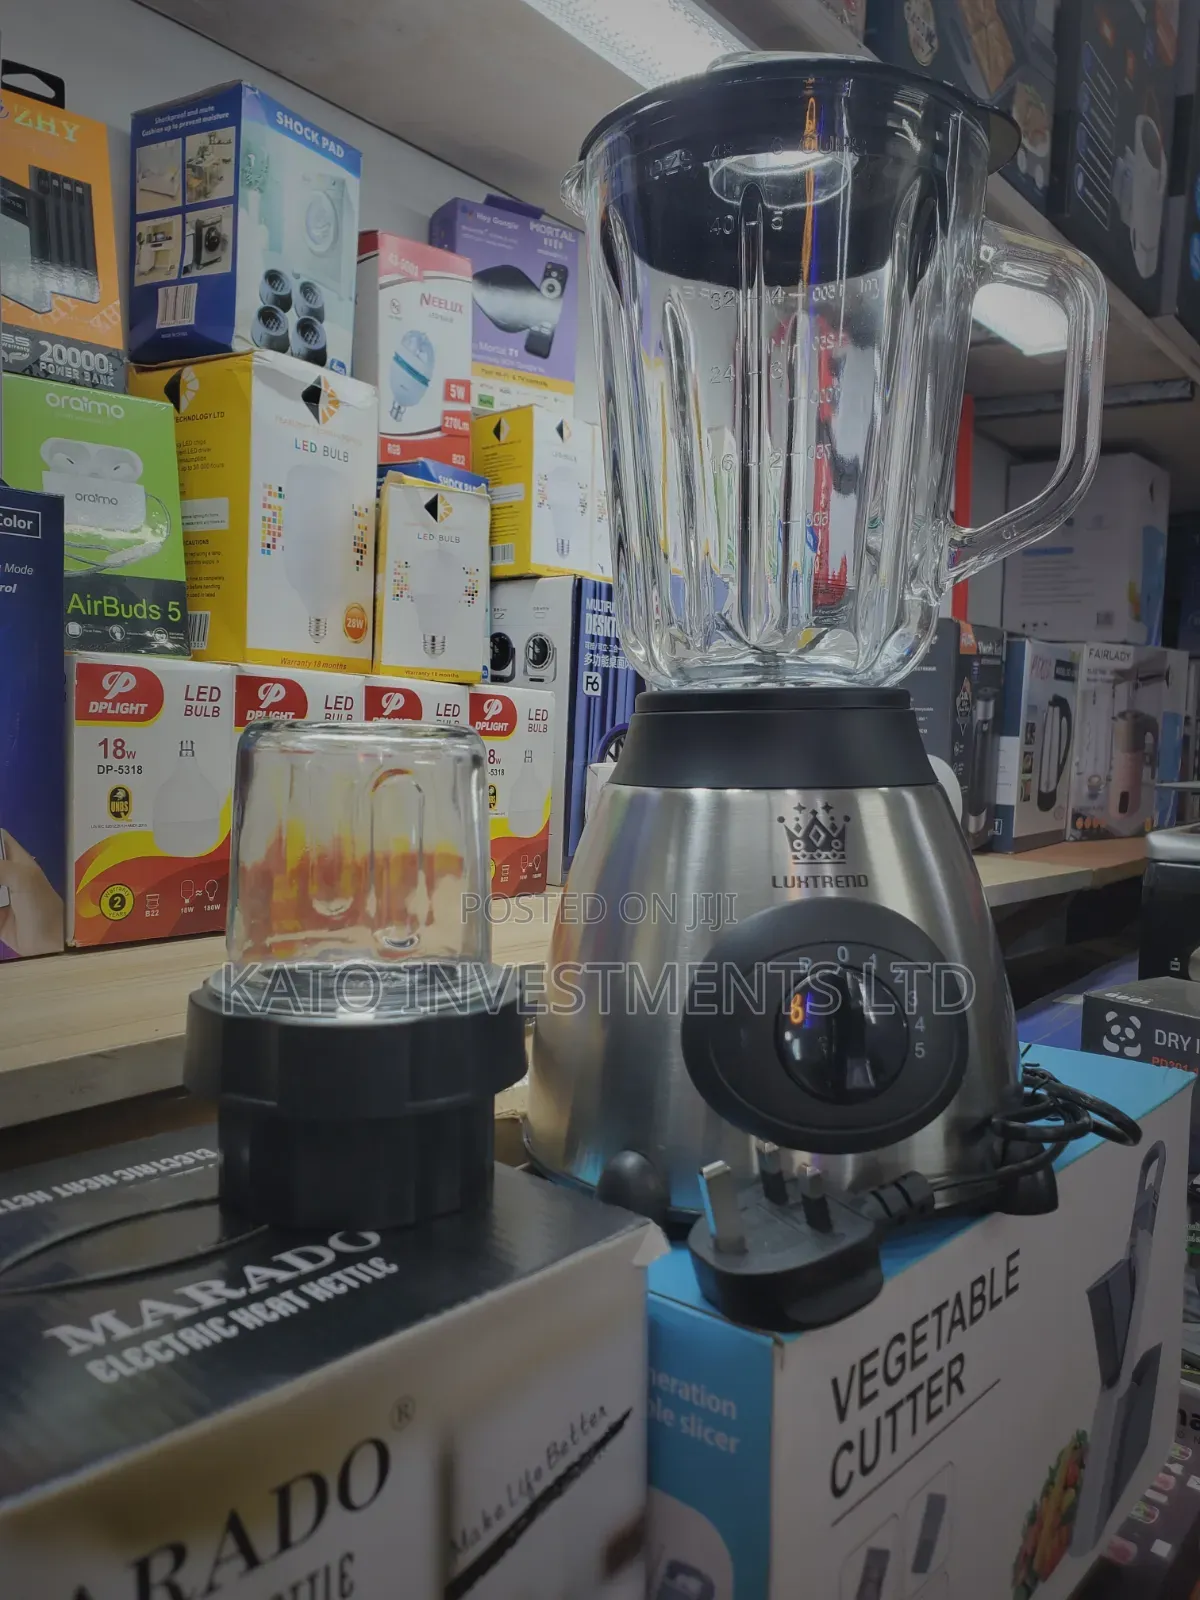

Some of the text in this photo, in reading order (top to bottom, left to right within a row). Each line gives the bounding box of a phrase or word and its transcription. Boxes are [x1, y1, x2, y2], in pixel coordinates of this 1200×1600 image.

[276, 110, 344, 158] SHOCK PAD
[38, 340, 109, 374] 20000
[39, 362, 115, 387] POWER BANK
[450, 384, 466, 400] 5W
[46, 392, 125, 418] oraimo
[294, 437, 349, 462] LED BULB
[75, 492, 118, 506] oraimo
[417, 532, 461, 543] LED BULB
[4, 562, 34, 576] Mode
[66, 593, 182, 622] AirBuds 5
[346, 617, 364, 629] 28W
[585, 613, 619, 638] DESKT
[1089, 648, 1131, 661] FAIRLADY
[280, 657, 312, 668] Warranty
[322, 662, 347, 670] months
[586, 676, 599, 692] F6
[184, 685, 221, 702] LED
[88, 701, 148, 715] DPLIGHT
[324, 695, 354, 710] LED
[436, 703, 460, 718] LED
[184, 705, 221, 718] BULB
[528, 709, 548, 721] LED
[475, 722, 508, 732] DPLIGHT
[527, 724, 548, 733] BULB
[96, 765, 143, 775] DP-5318
[771, 874, 869, 889] LUXTREND
[104, 886, 131, 898] Warranty
[113, 896, 122, 908] 2
[914, 1016, 925, 1032] 4
[1155, 1029, 1191, 1051] DRY
[915, 1042, 925, 1058] 5
[85, 1316, 240, 1384] ELECTRIC
[229, 1291, 311, 1331] HEAT
[832, 1248, 1020, 1424] VEGETABLE
[680, 1413, 740, 1454] slicer
[830, 1352, 965, 1499] CUTTER
[547, 1405, 608, 1470] Better
[70, 1436, 390, 1600] RADO
